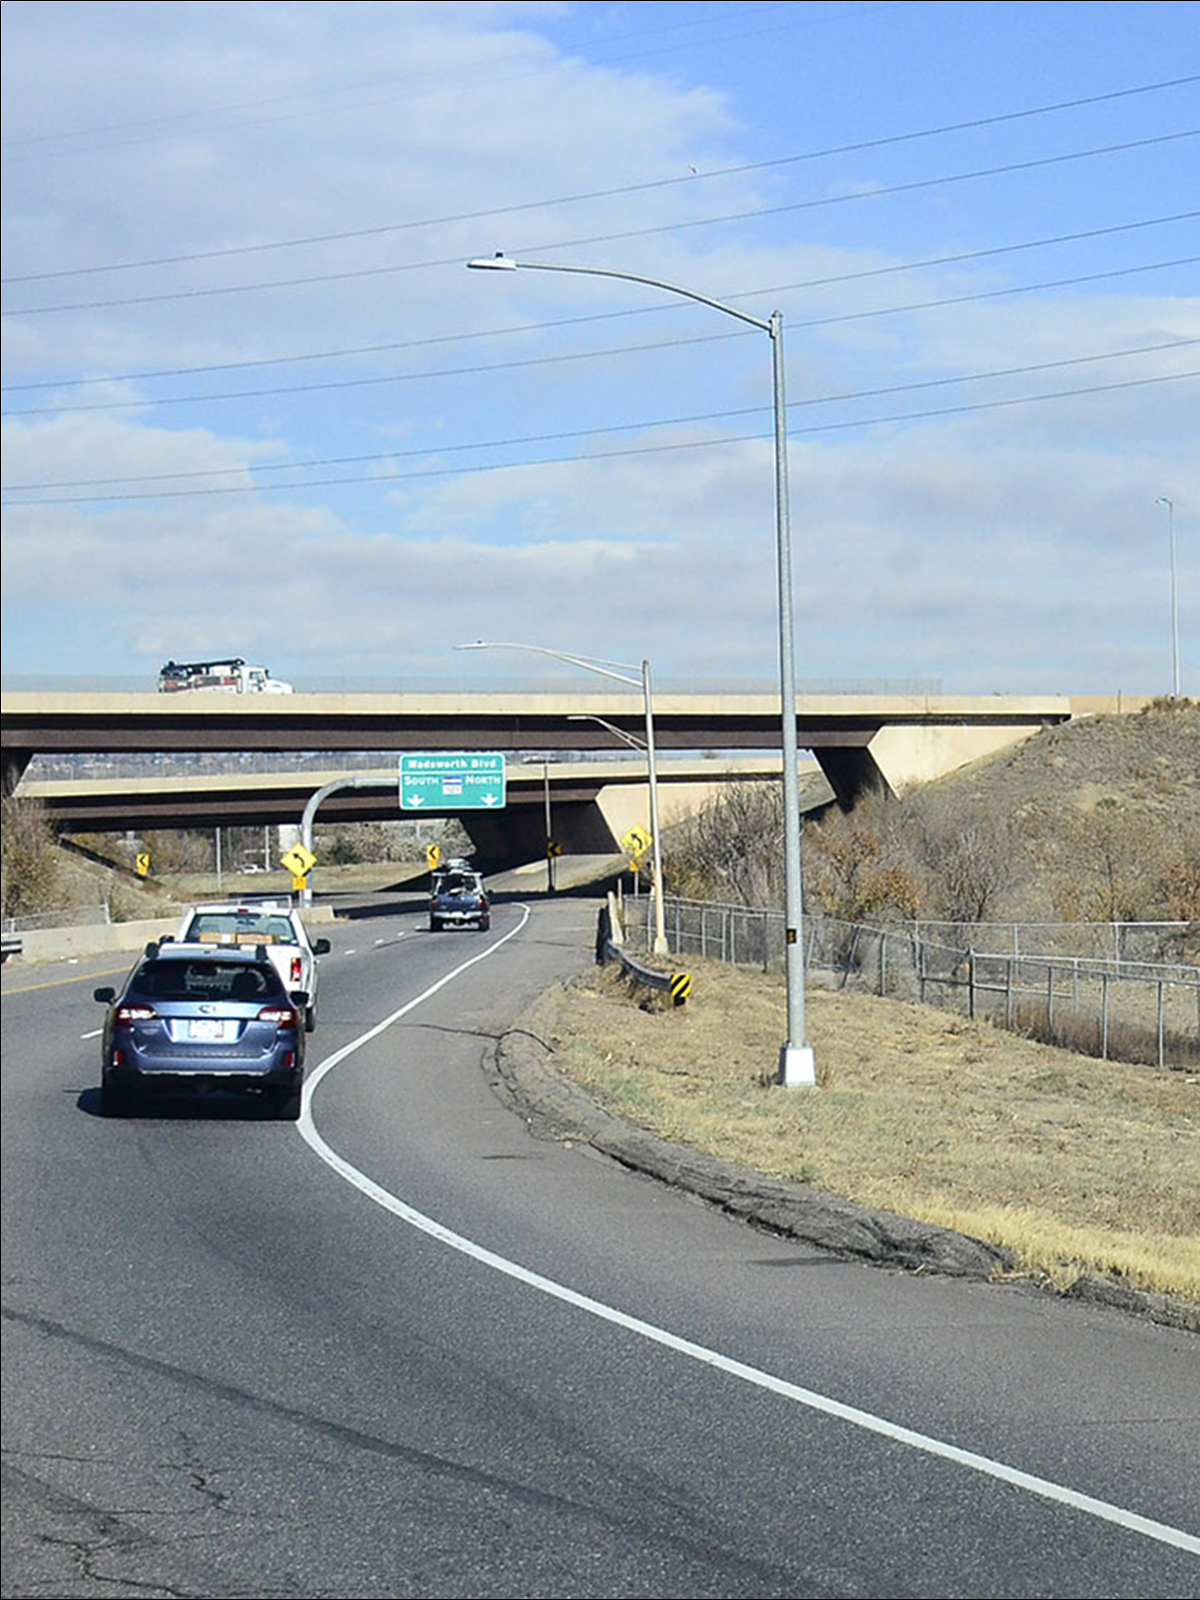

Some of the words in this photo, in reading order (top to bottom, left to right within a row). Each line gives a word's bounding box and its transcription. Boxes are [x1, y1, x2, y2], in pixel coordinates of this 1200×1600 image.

[408, 758, 468, 768] Wadsworth
[471, 759, 497, 768] Blvd
[404, 776, 439, 785] SOUTH
[465, 775, 500, 785] NORTH
